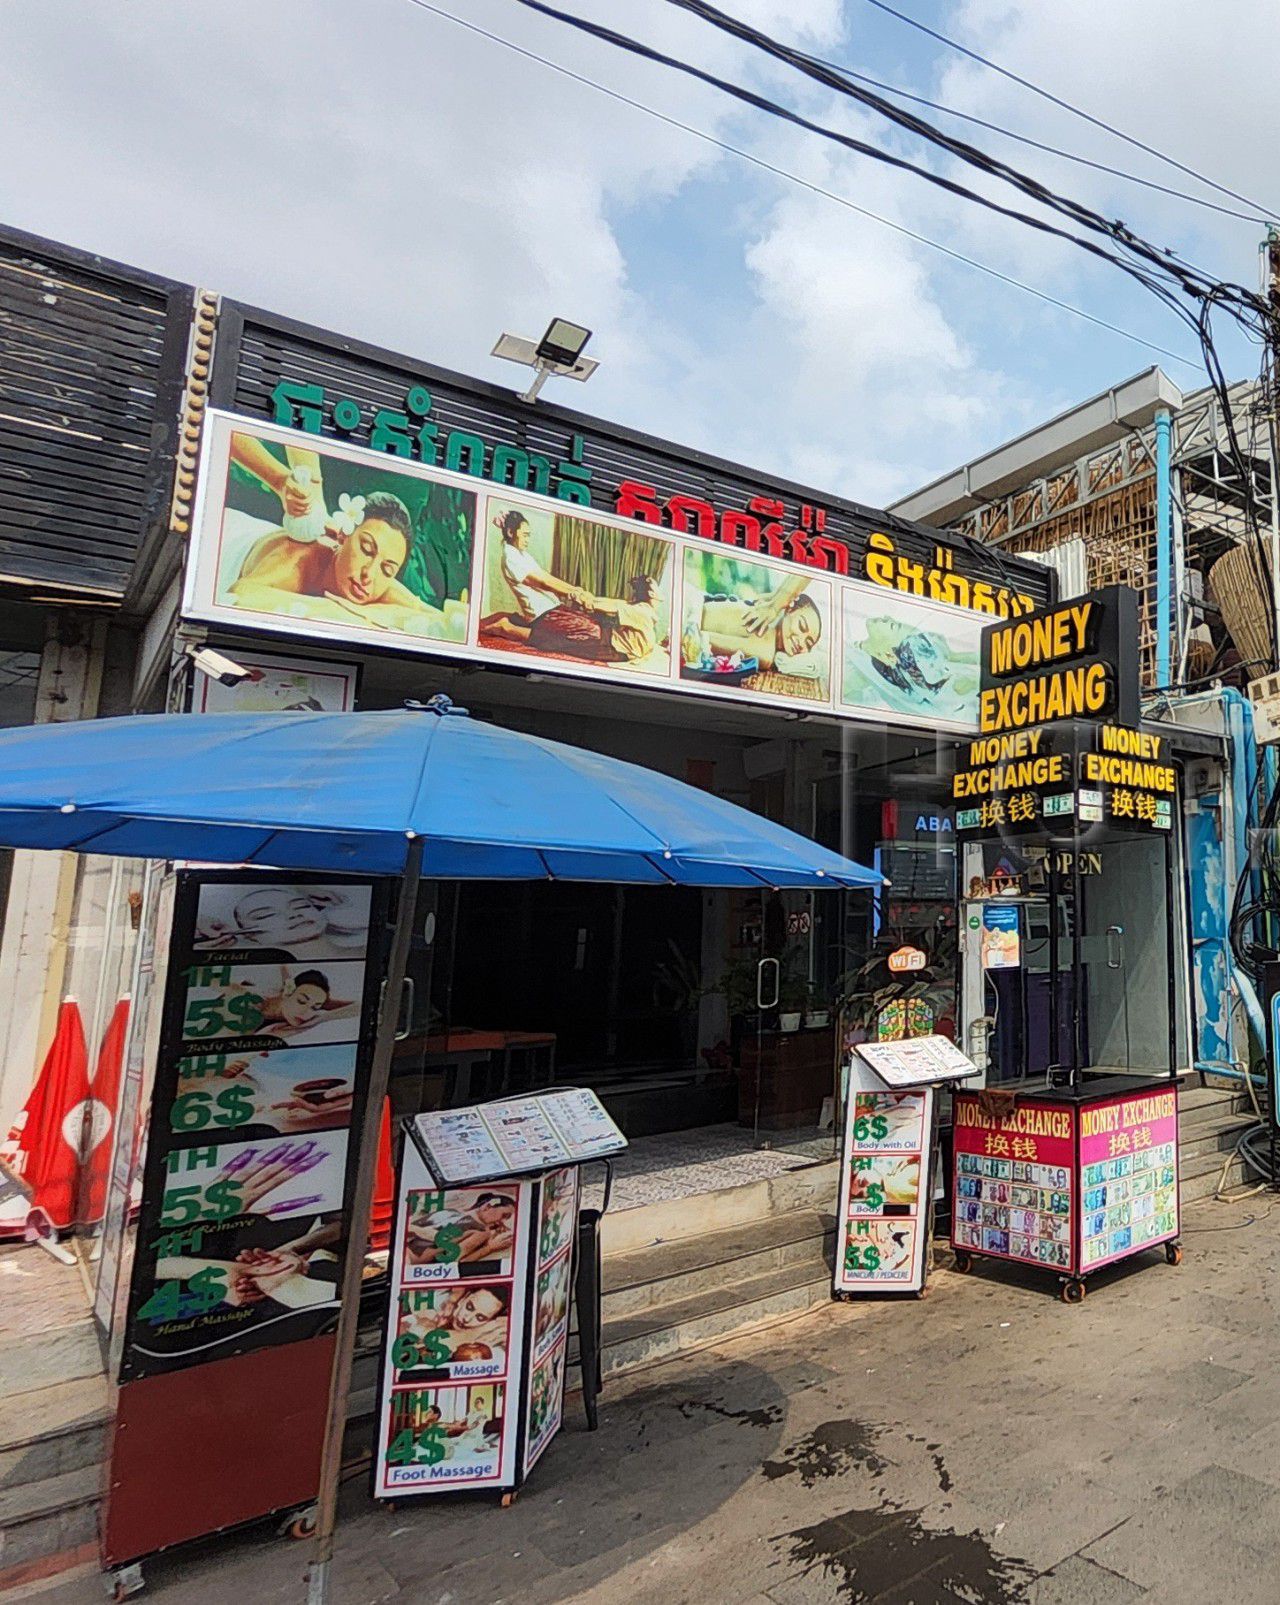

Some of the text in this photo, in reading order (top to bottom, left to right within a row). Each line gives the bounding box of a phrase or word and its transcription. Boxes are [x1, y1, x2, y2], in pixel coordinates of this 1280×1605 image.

[991, 602, 1092, 674] MONEY
[980, 663, 1105, 732] EXCHANG
[970, 728, 1043, 766] MONEY
[1102, 725, 1161, 760] MONEY
[953, 756, 1063, 798] EXCHANGE
[1086, 755, 1175, 792] EXCHANGE
[979, 790, 1036, 829] 换钱
[1111, 788, 1157, 822] 换钱
[915, 816, 952, 832] ABA
[1044, 853, 1102, 875] OPEN
[180, 965, 231, 987] 1H
[184, 992, 264, 1037] 5$
[169, 1084, 256, 1131] 6$
[1082, 1093, 1175, 1138] MONEY EXCHANGE
[853, 1114, 888, 1142] 6$
[1108, 1126, 1153, 1157] 换钱
[161, 1145, 218, 1173] 1H
[857, 1141, 917, 1150] Body with Oil
[985, 1132, 1038, 1160] 换钱
[159, 1180, 245, 1229] 5$
[413, 1266, 452, 1279] Body
[845, 1245, 880, 1272] 5$
[392, 1328, 450, 1370] 6$
[453, 1363, 500, 1377] Massage
[389, 1390, 429, 1412] 1H
[385, 1424, 447, 1467] 4$
[393, 1463, 492, 1481] Foot Massage
